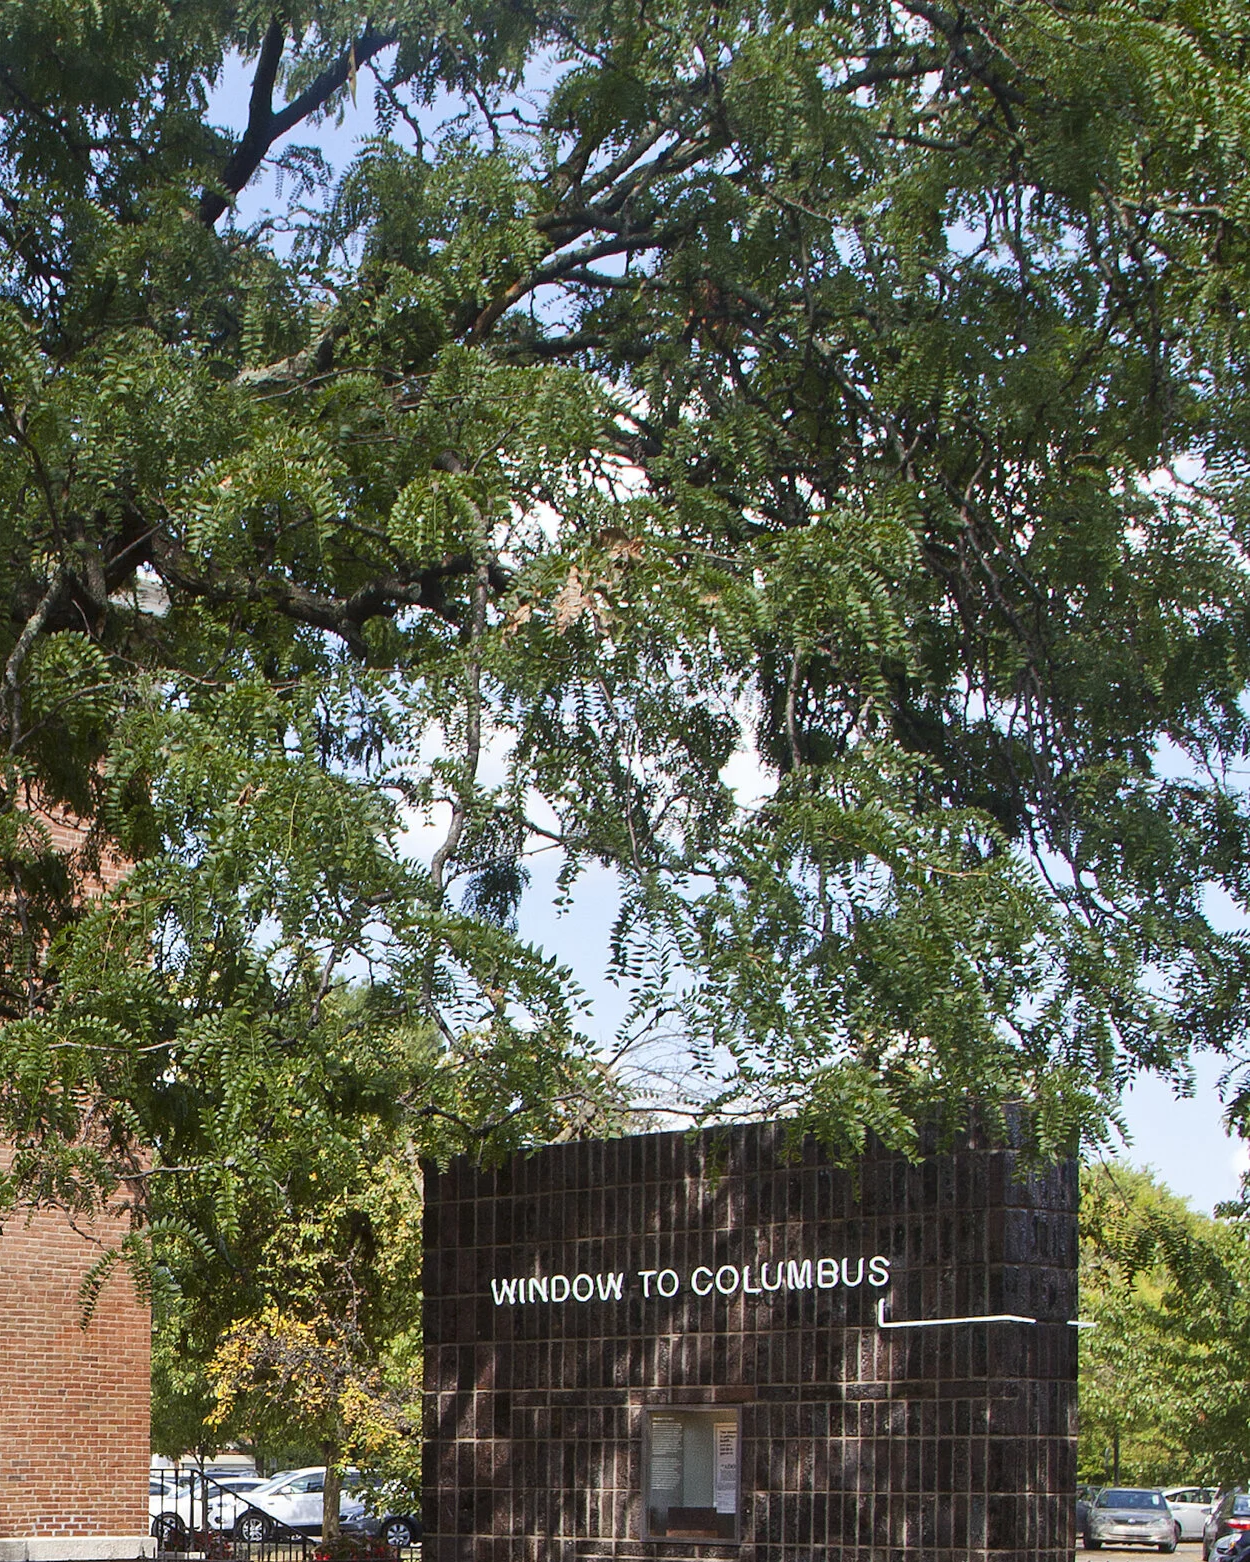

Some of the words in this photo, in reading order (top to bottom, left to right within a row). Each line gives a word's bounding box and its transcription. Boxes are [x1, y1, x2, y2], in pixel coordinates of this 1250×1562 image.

[490, 1272, 624, 1306] WINDOW
[637, 1268, 680, 1300] TO
[690, 1255, 891, 1296] COLUMBUS
